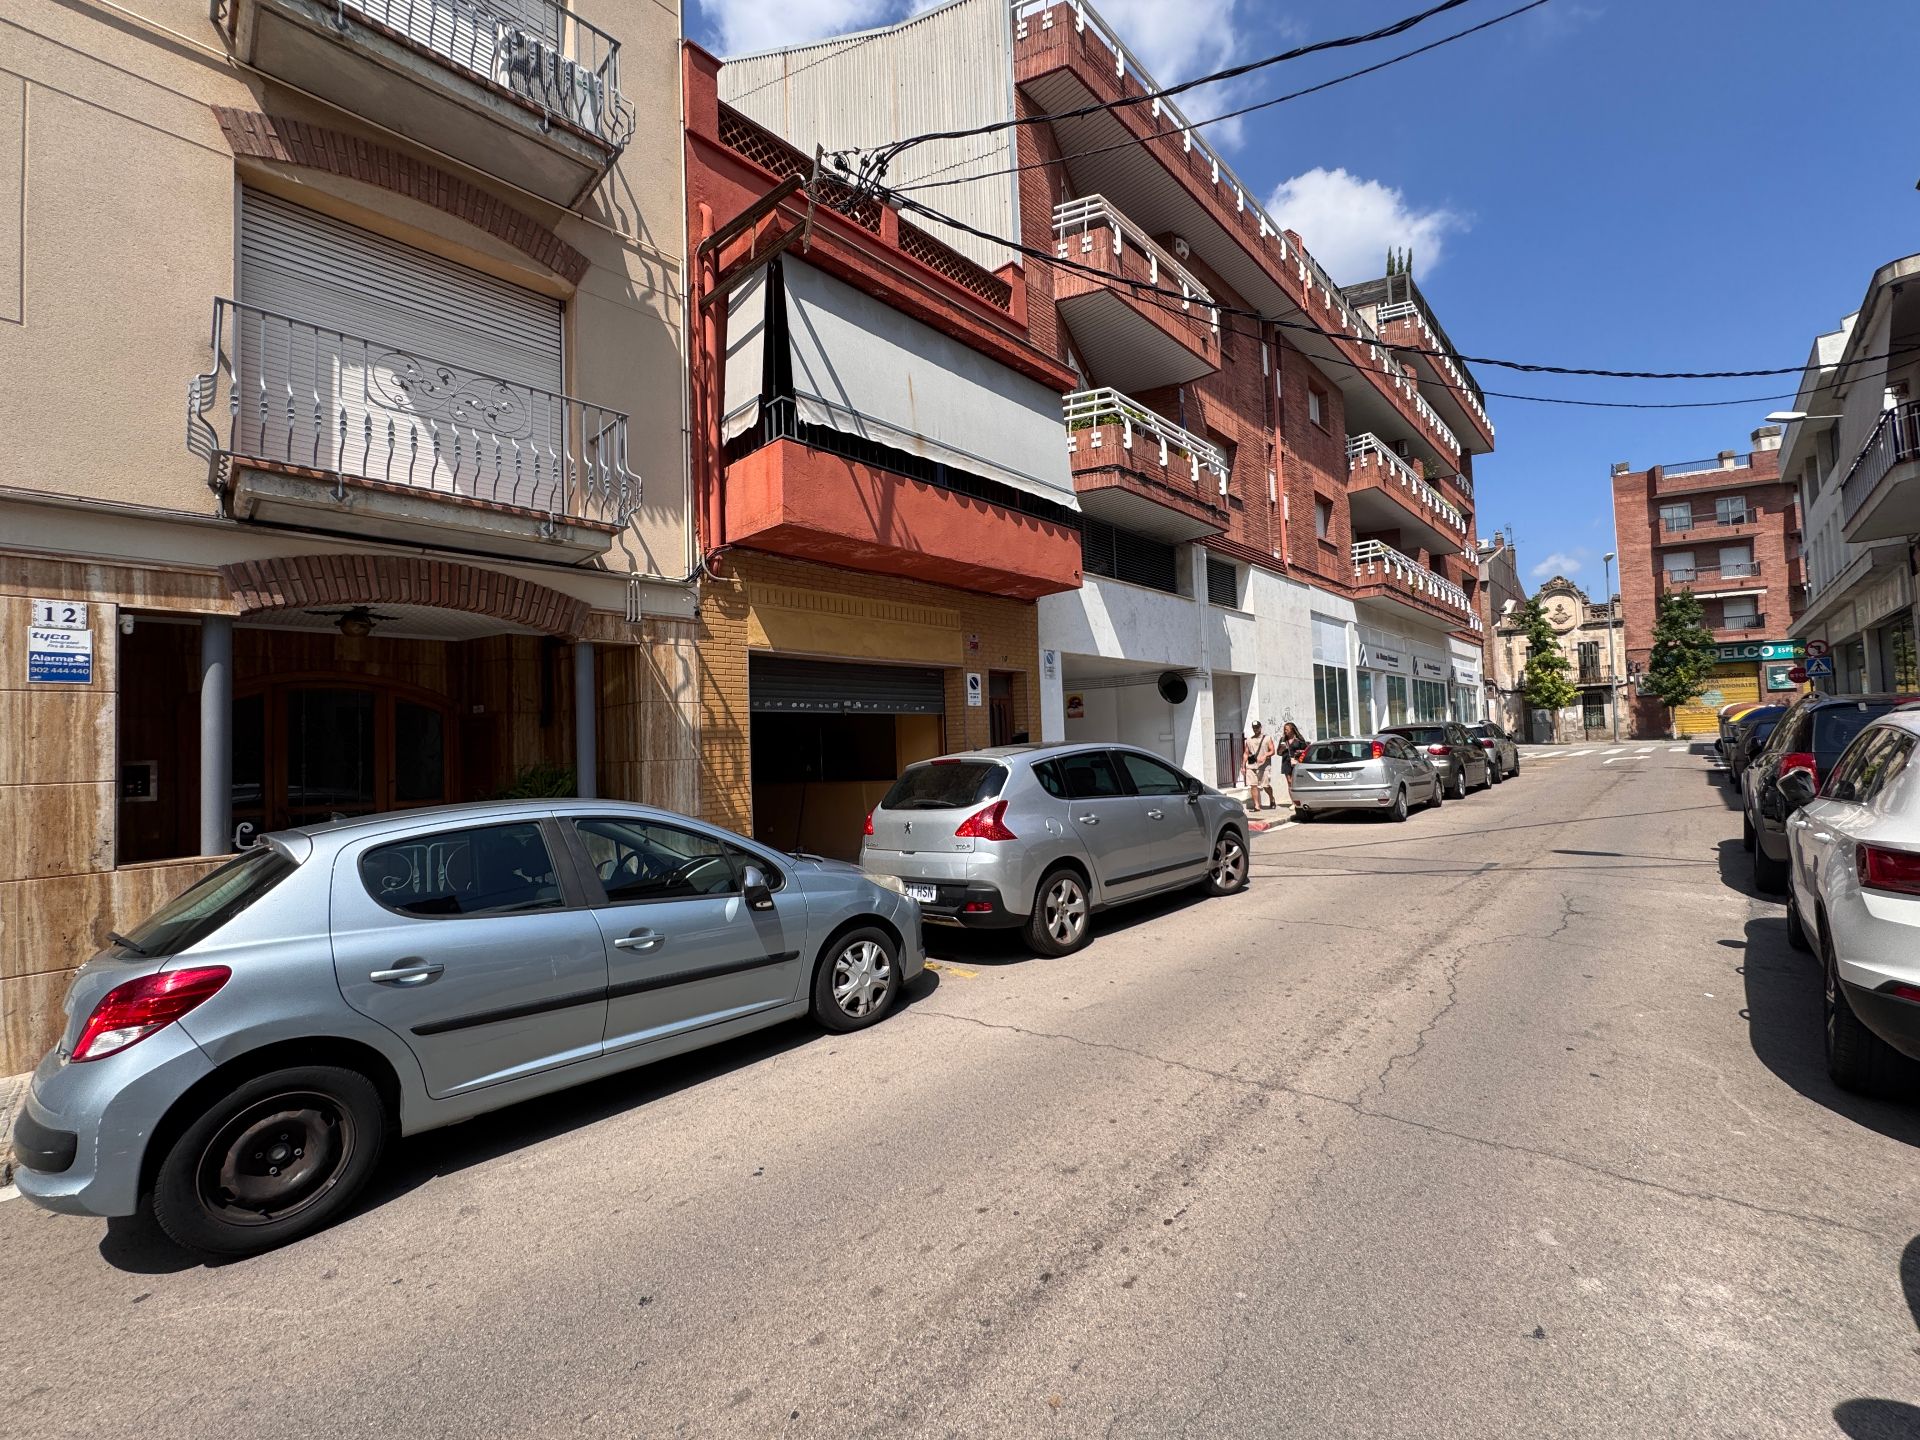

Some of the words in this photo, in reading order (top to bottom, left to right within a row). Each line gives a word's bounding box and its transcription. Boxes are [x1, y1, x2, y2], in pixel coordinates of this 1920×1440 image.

[43, 606, 77, 623] 12
[31, 631, 71, 641] tyco
[31, 654, 74, 662] Alarma
[917, 886, 934, 899] HSN
